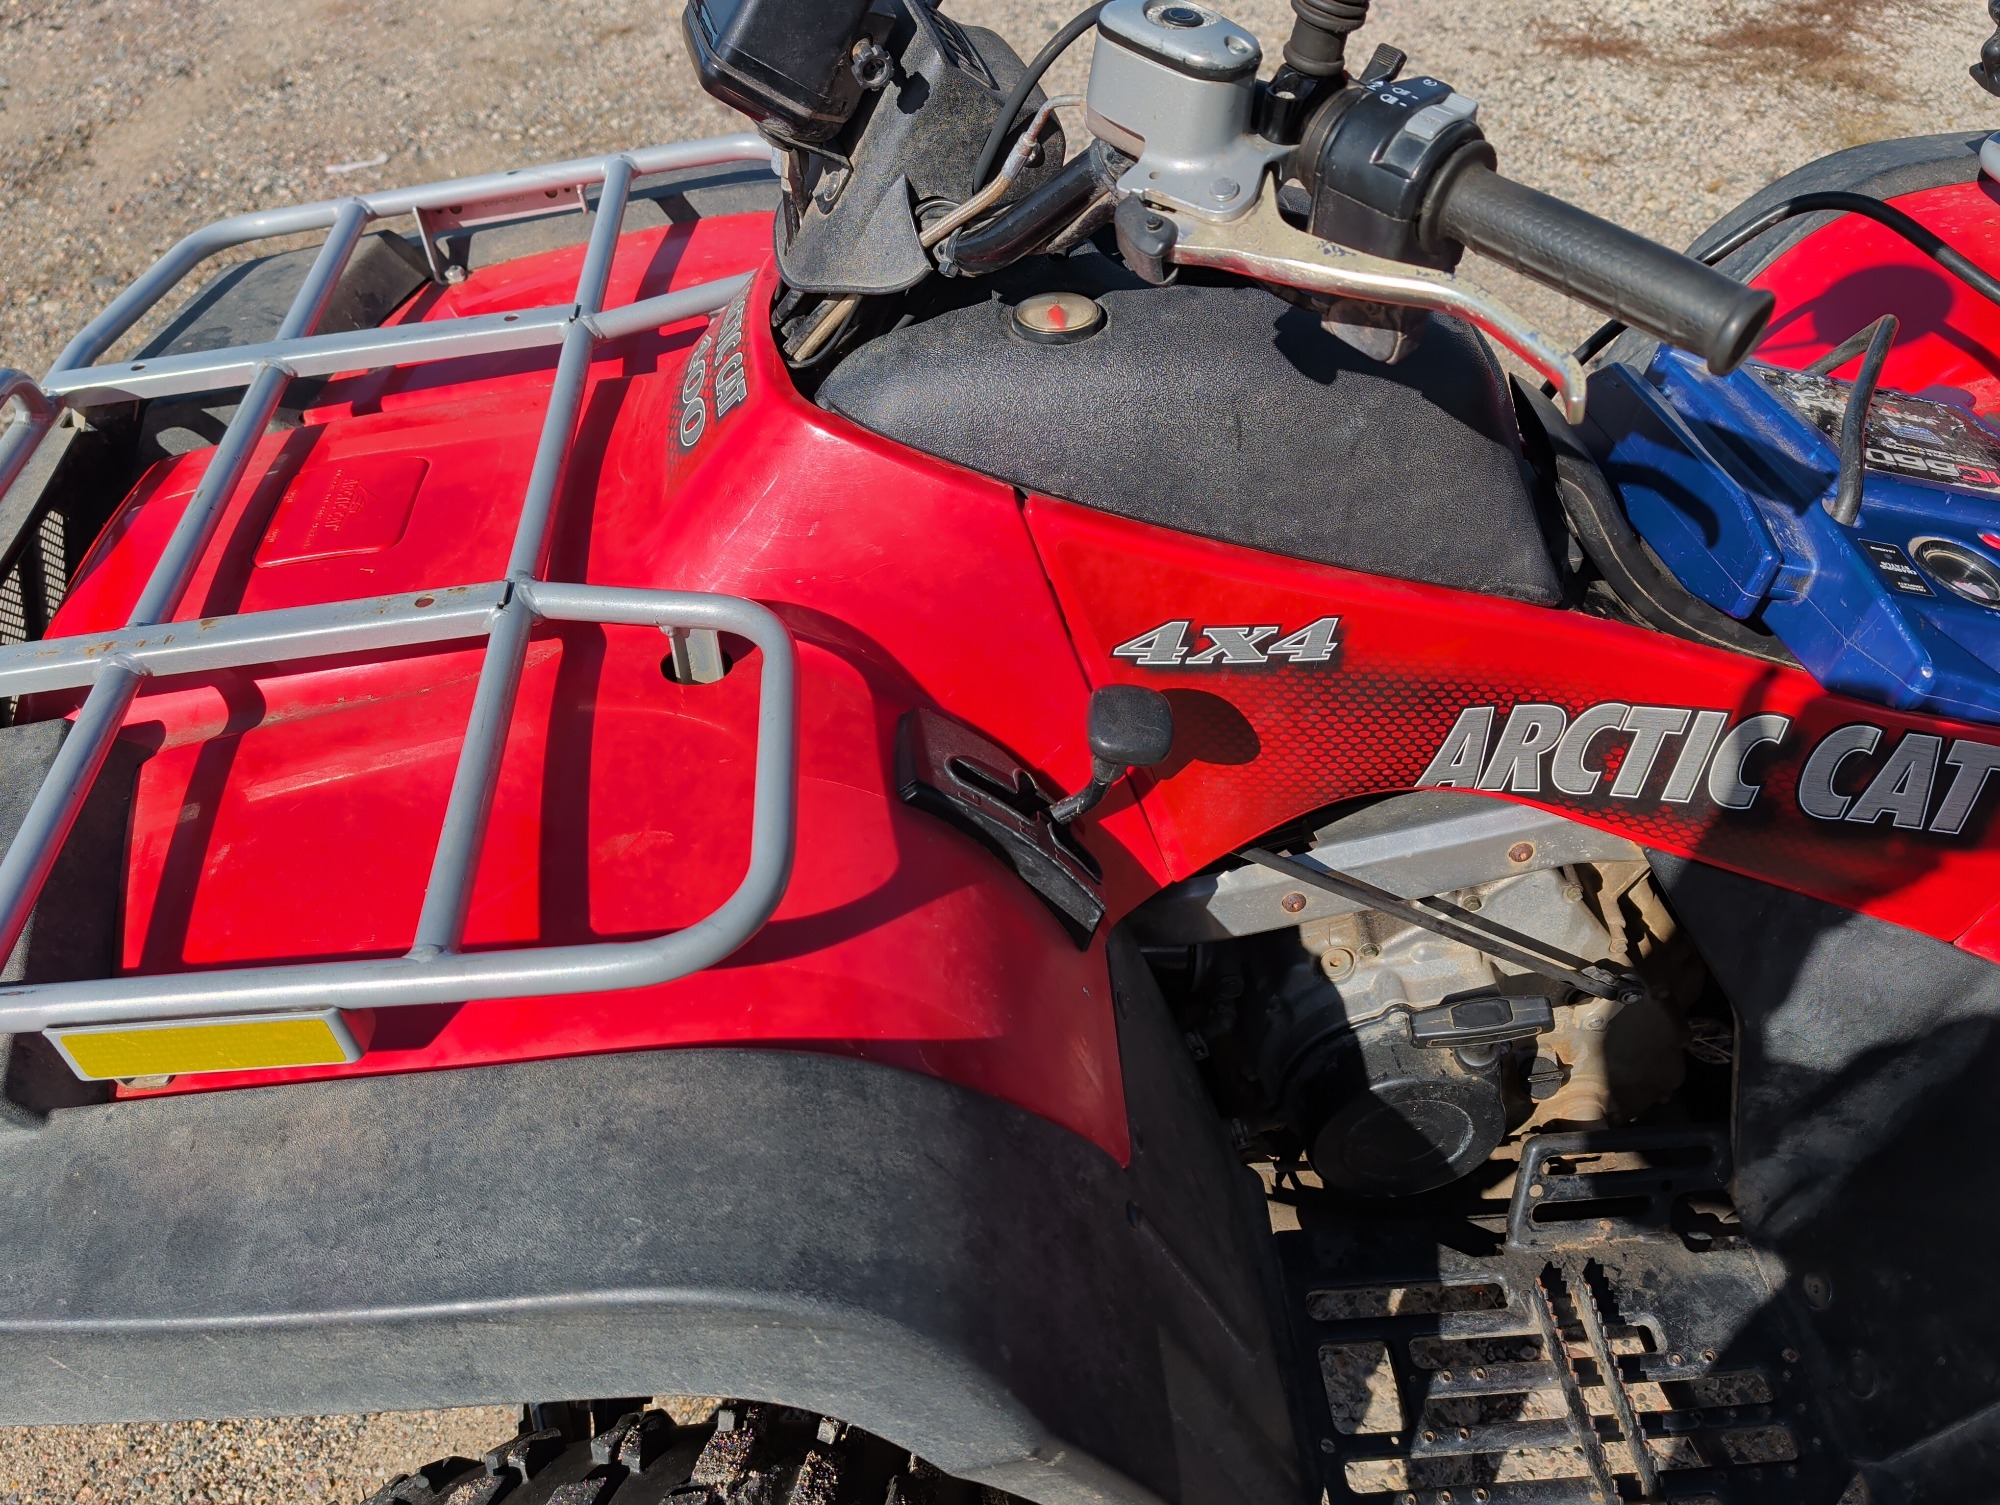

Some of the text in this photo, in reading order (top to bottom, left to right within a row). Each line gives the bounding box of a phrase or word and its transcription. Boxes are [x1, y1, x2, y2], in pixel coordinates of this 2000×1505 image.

[680, 334, 712, 447] 400
[715, 351, 748, 418] CAT
[1111, 615, 1340, 666] 4x4
[1415, 703, 2000, 835] ARCTIC CAT
